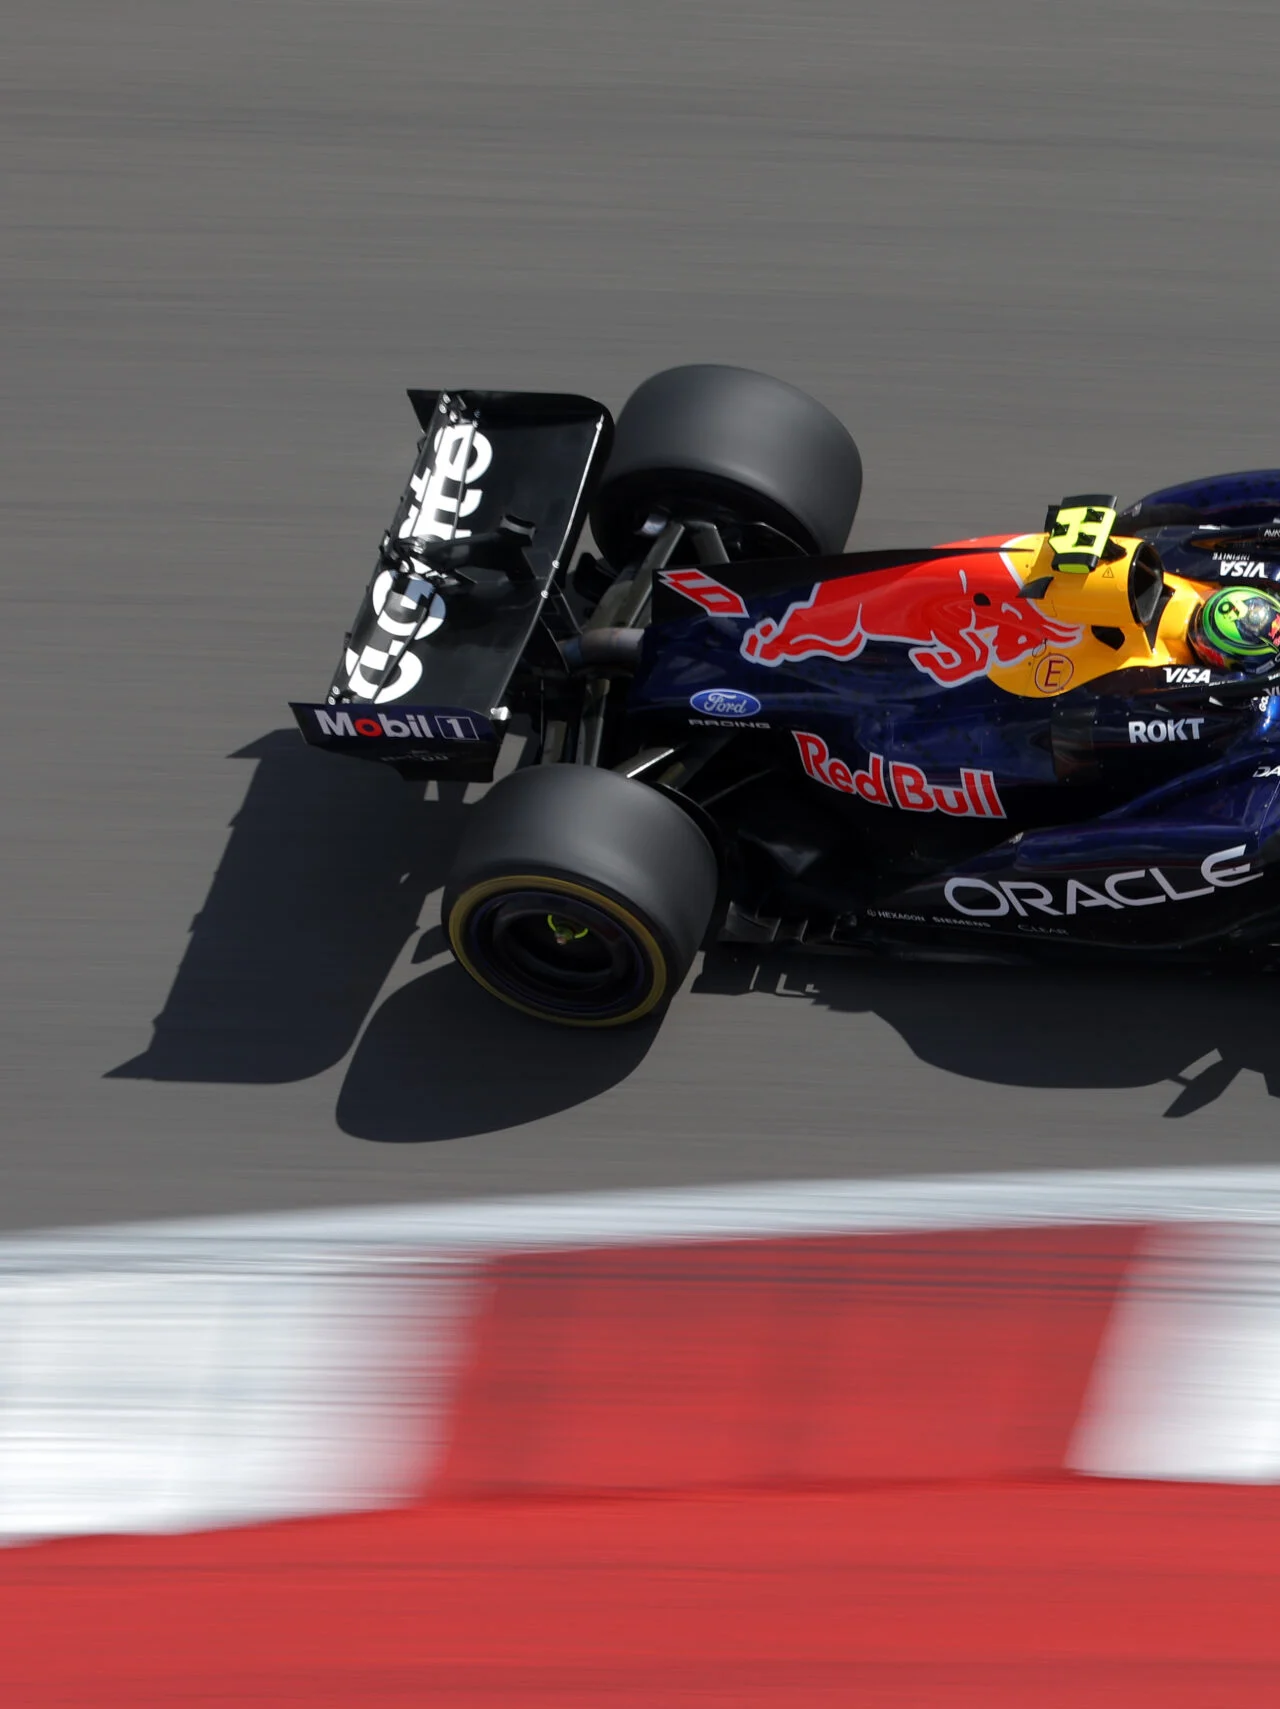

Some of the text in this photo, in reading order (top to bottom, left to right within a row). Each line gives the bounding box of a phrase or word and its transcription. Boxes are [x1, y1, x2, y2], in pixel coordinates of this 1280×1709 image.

[1219, 560, 1268, 578] VISA
[1163, 668, 1211, 683] VISA
[704, 693, 747, 713] Ford
[314, 709, 435, 739] Mobil
[688, 719, 771, 729] RACING
[1129, 718, 1205, 743] ROKT
[792, 730, 1006, 818] Red Bull
[944, 845, 1264, 916] ORACLE
[878, 910, 926, 923] HEXAGON
[932, 916, 991, 928] SIEMENS
